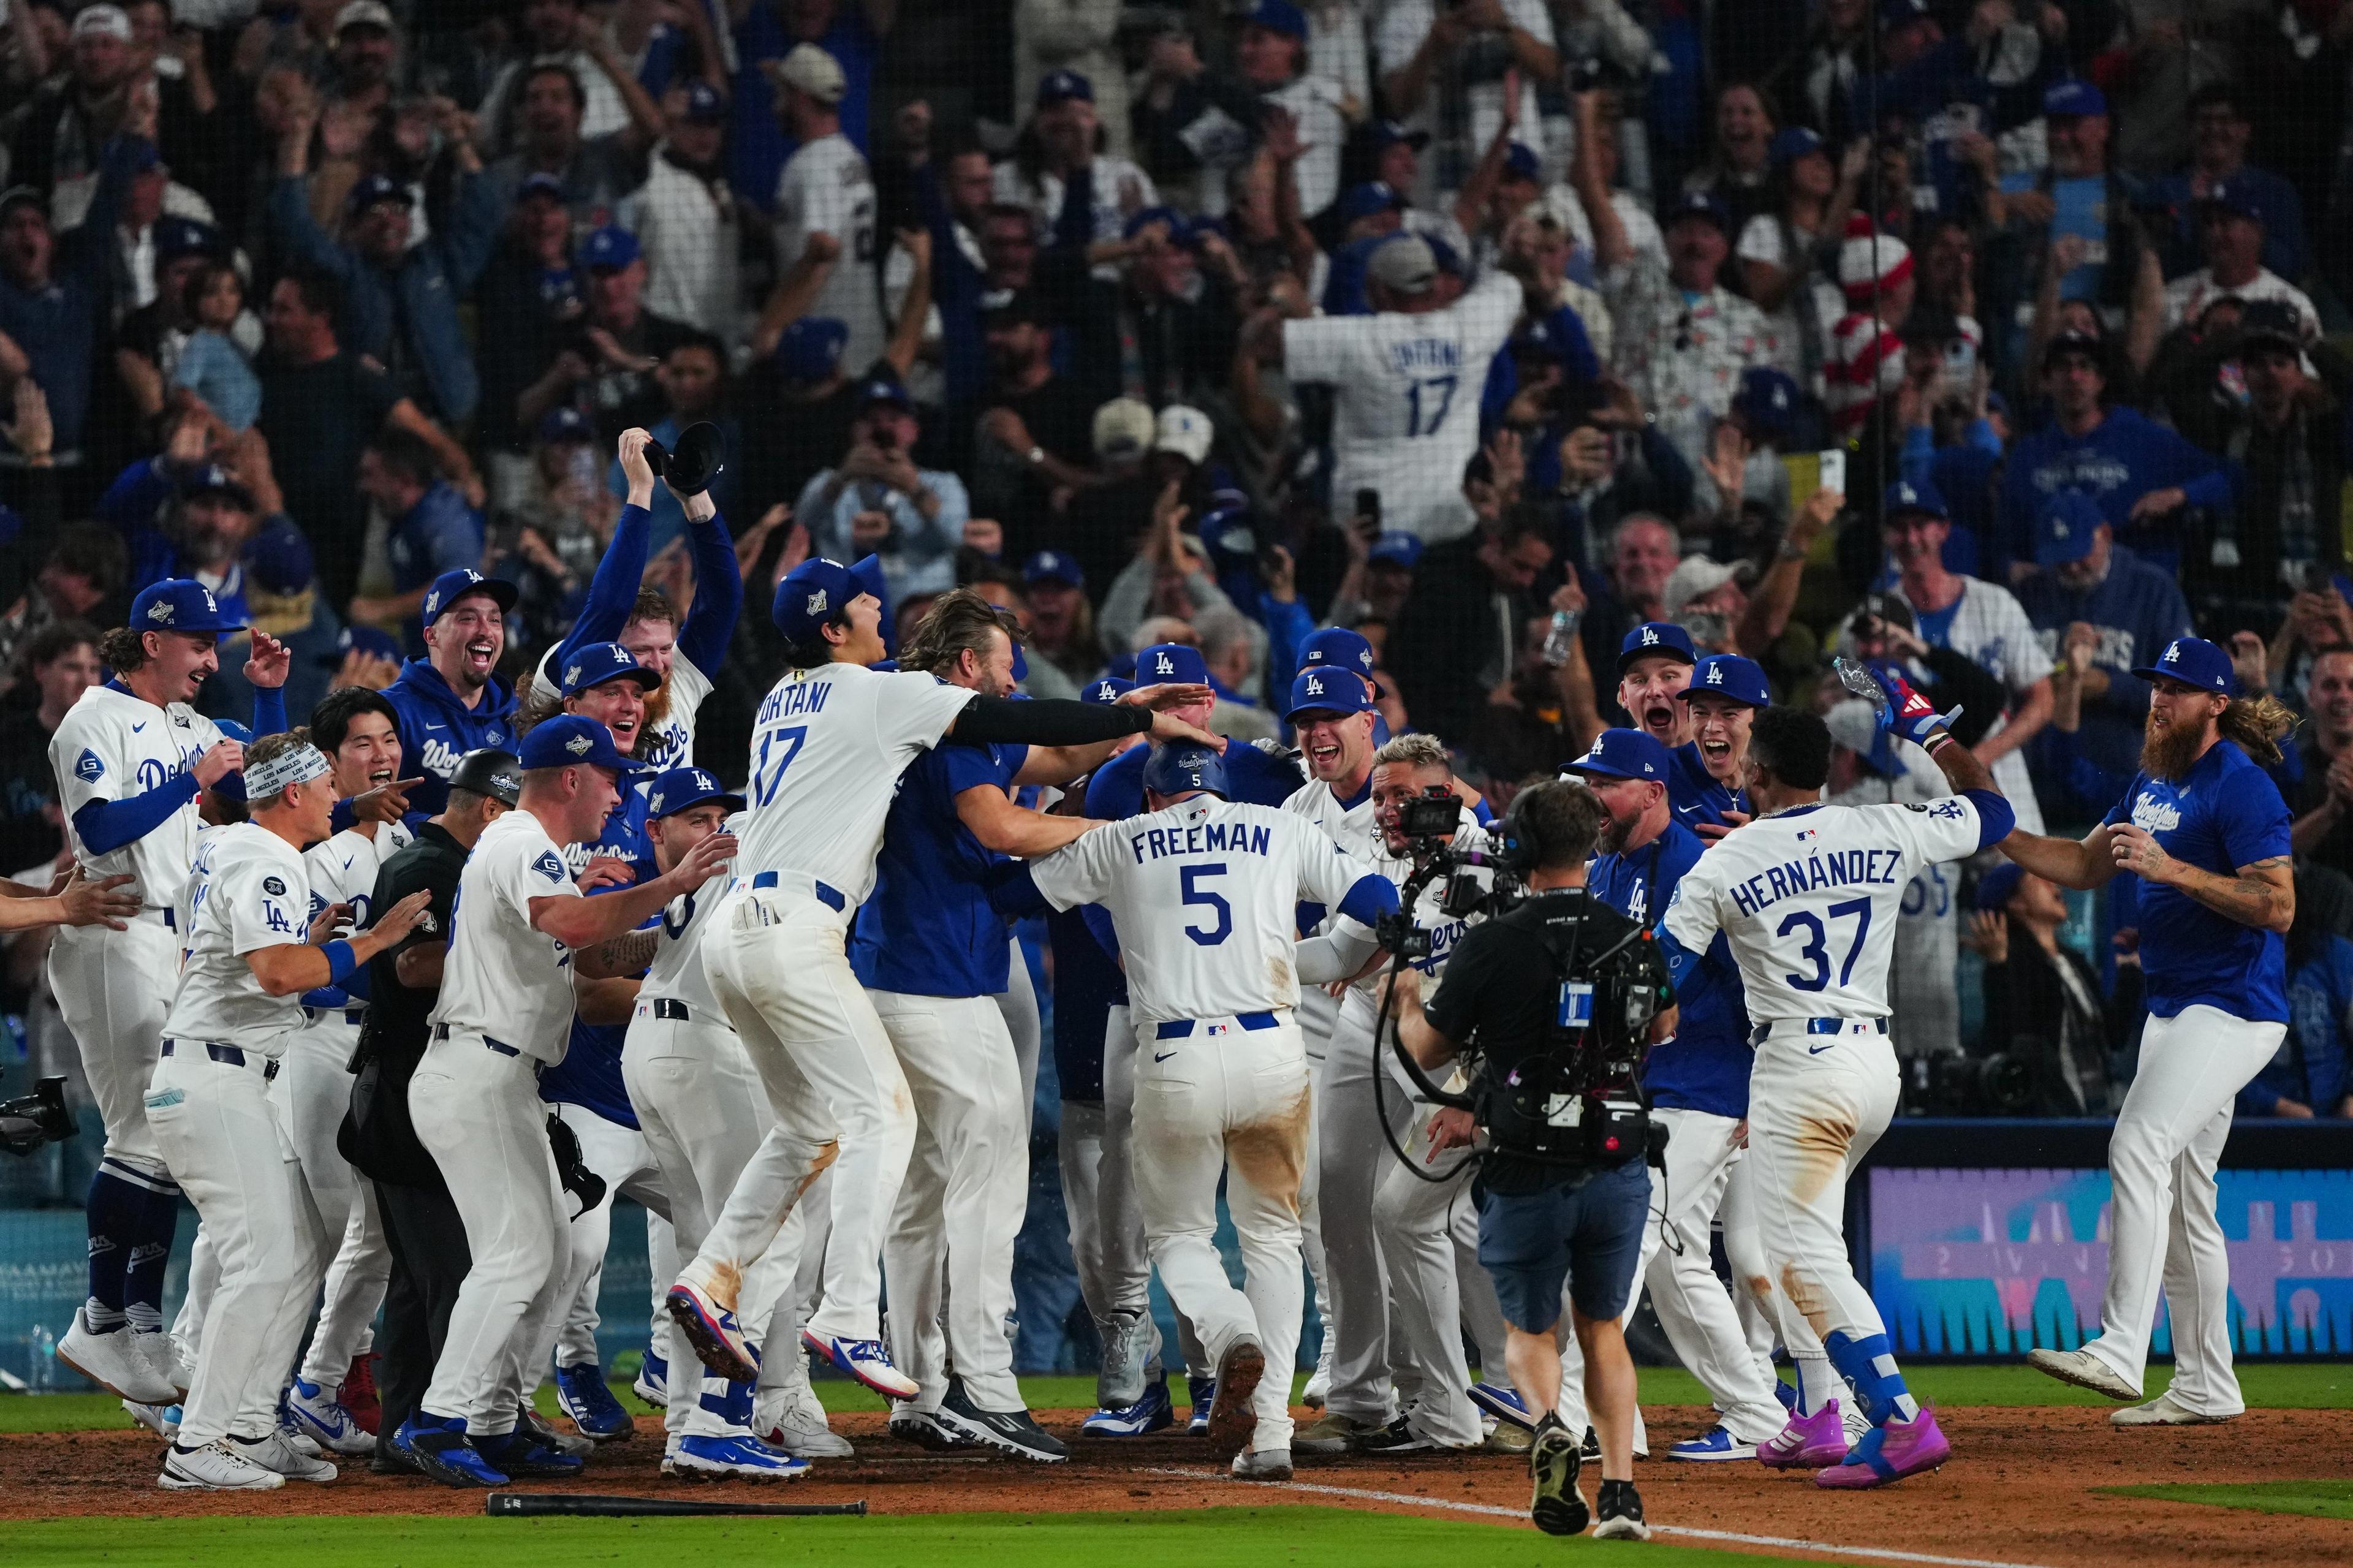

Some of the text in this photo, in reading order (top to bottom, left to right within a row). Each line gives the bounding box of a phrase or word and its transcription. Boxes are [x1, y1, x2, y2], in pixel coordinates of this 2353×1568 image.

[1404, 375, 1458, 437] 17
[464, 569, 484, 583] LA
[203, 589, 218, 612] LA
[1642, 626, 1659, 645] LA
[608, 644, 631, 663] LA
[2164, 641, 2180, 662] LA
[1156, 652, 1173, 674] LA
[1707, 662, 1722, 684] LA
[1099, 681, 1116, 700] LA
[1306, 675, 1324, 695] LA
[759, 682, 832, 725] OHTANI
[1591, 733, 1604, 754] LA
[252, 763, 273, 777] ANGELES
[276, 759, 301, 775] ANGELES
[292, 767, 304, 776] LOS
[305, 756, 322, 768] ANGELES
[754, 725, 808, 811] 17
[1178, 757, 1209, 768] World Series
[256, 778, 279, 792] ANGELES
[490, 775, 507, 786] World
[691, 770, 714, 790] LA
[1192, 774, 1201, 787] 5
[1929, 800, 1963, 819] LA
[1131, 824, 1271, 865] FREEMAN
[544, 858, 558, 871] G
[268, 883, 282, 894] 34
[1729, 847, 1901, 918] HERNÁNDEZ
[1180, 863, 1232, 946] 5
[1627, 877, 1647, 923] LA
[263, 900, 292, 933] LA
[1776, 895, 1872, 992] 37
